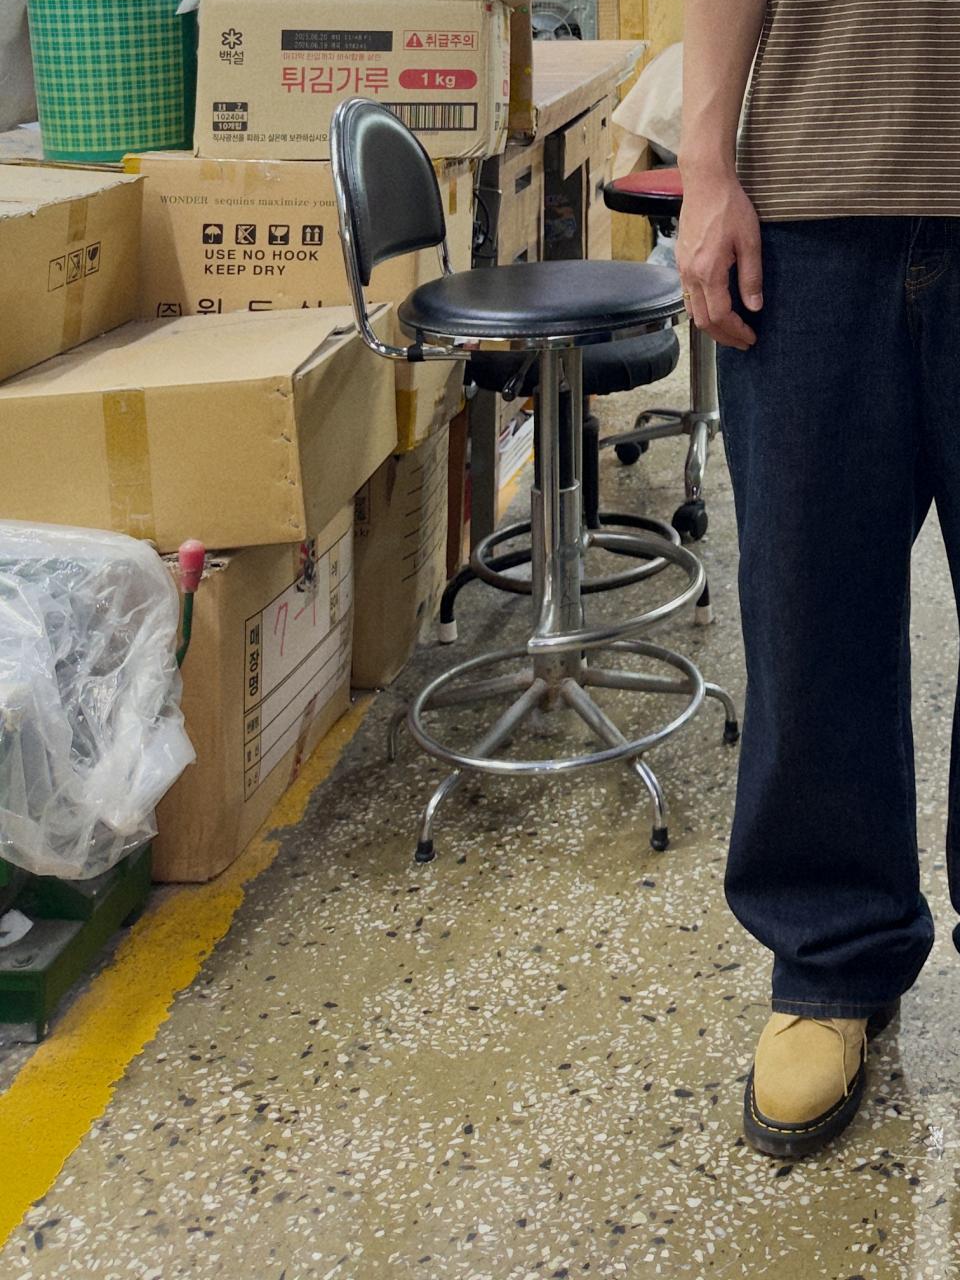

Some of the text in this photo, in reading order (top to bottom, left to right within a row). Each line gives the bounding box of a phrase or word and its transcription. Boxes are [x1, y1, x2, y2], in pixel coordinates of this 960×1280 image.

[425, 34, 475, 49] 취급주의
[219, 50, 245, 66] 백설
[281, 67, 389, 94] 튀김가루
[435, 73, 456, 88] kg
[160, 195, 209, 205] WONDER
[214, 197, 255, 208] sequins
[258, 198, 310, 208] maximize
[204, 249, 319, 261] USE NO HOOK
[204, 264, 286, 276] KEEP DRY
